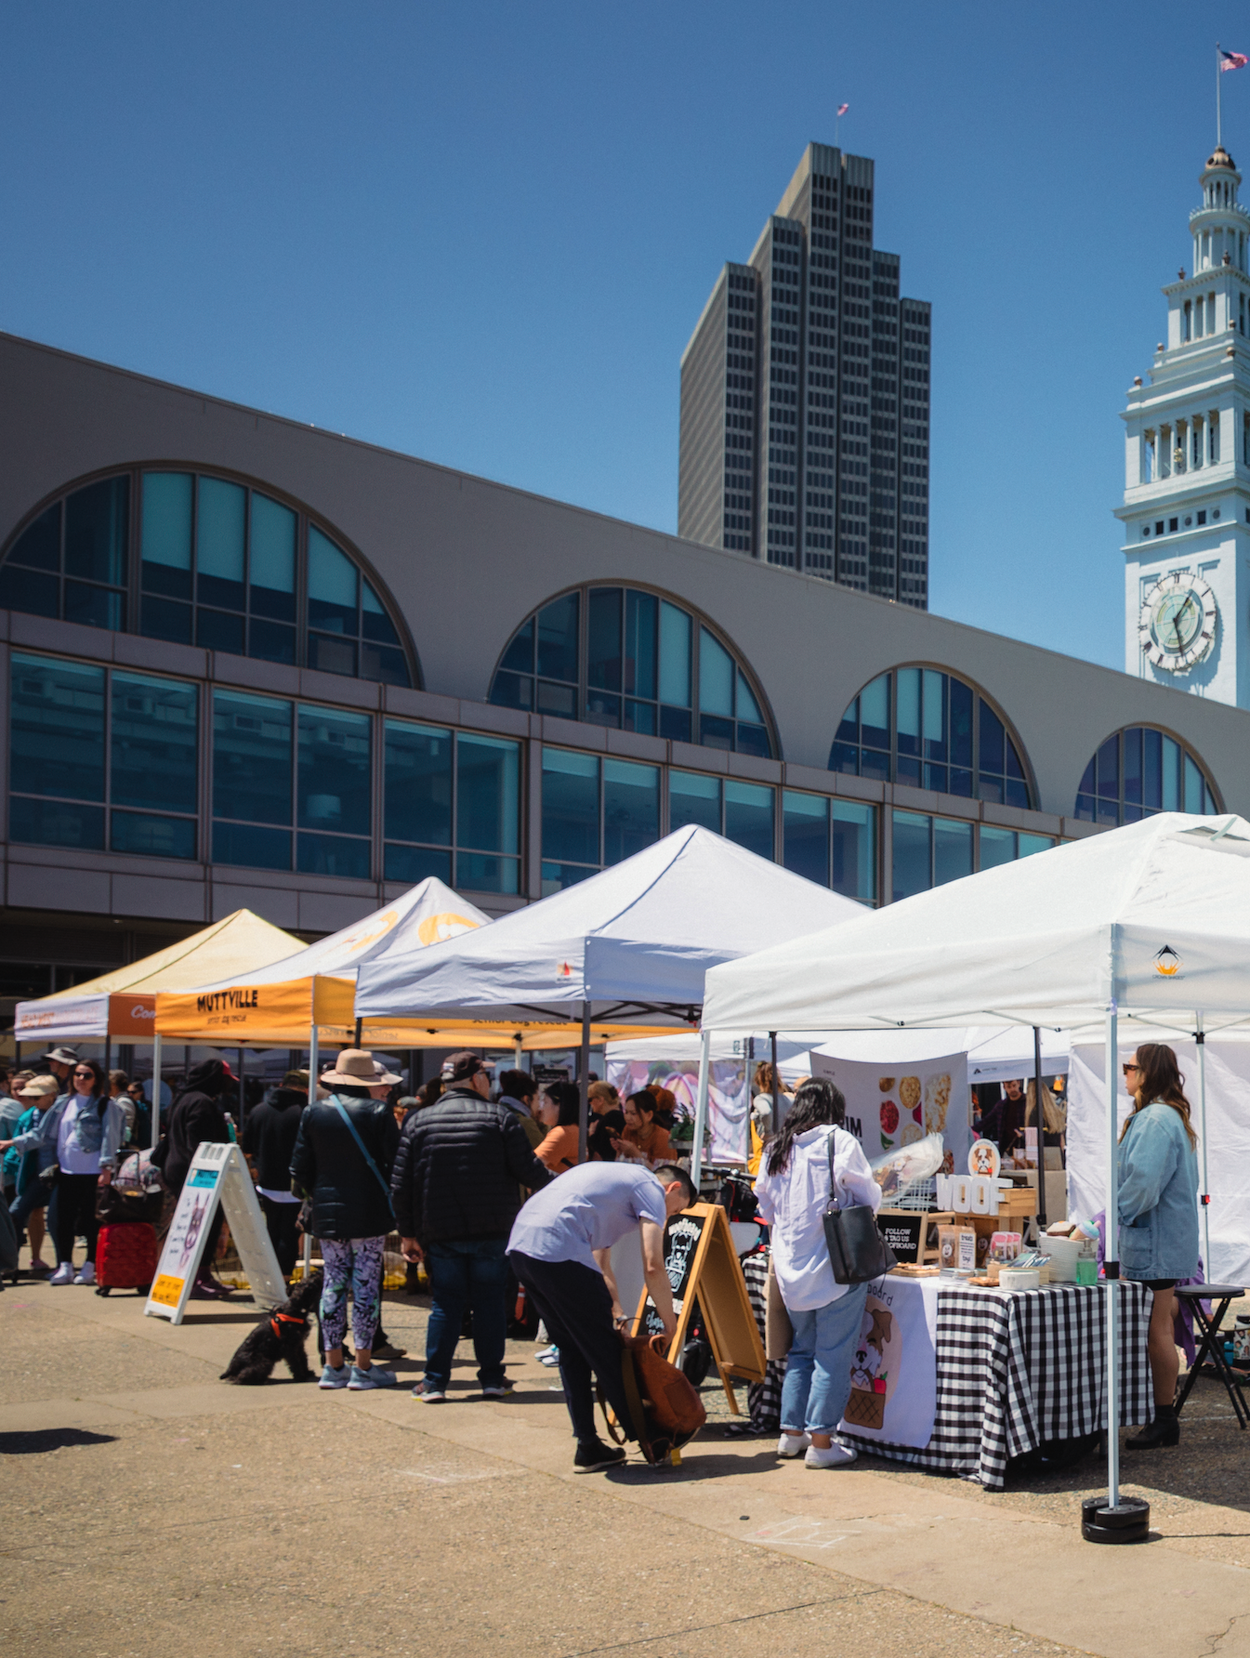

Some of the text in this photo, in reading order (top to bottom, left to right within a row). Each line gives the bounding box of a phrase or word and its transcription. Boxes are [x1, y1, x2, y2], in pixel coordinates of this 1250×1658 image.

[197, 989, 259, 1012] MUTTVILLE
[842, 1115, 863, 1138] IM
[936, 1173, 1014, 1216] WOOF
[885, 1227, 911, 1236] FOLLOW
[888, 1242, 917, 1250] OFBOARD
